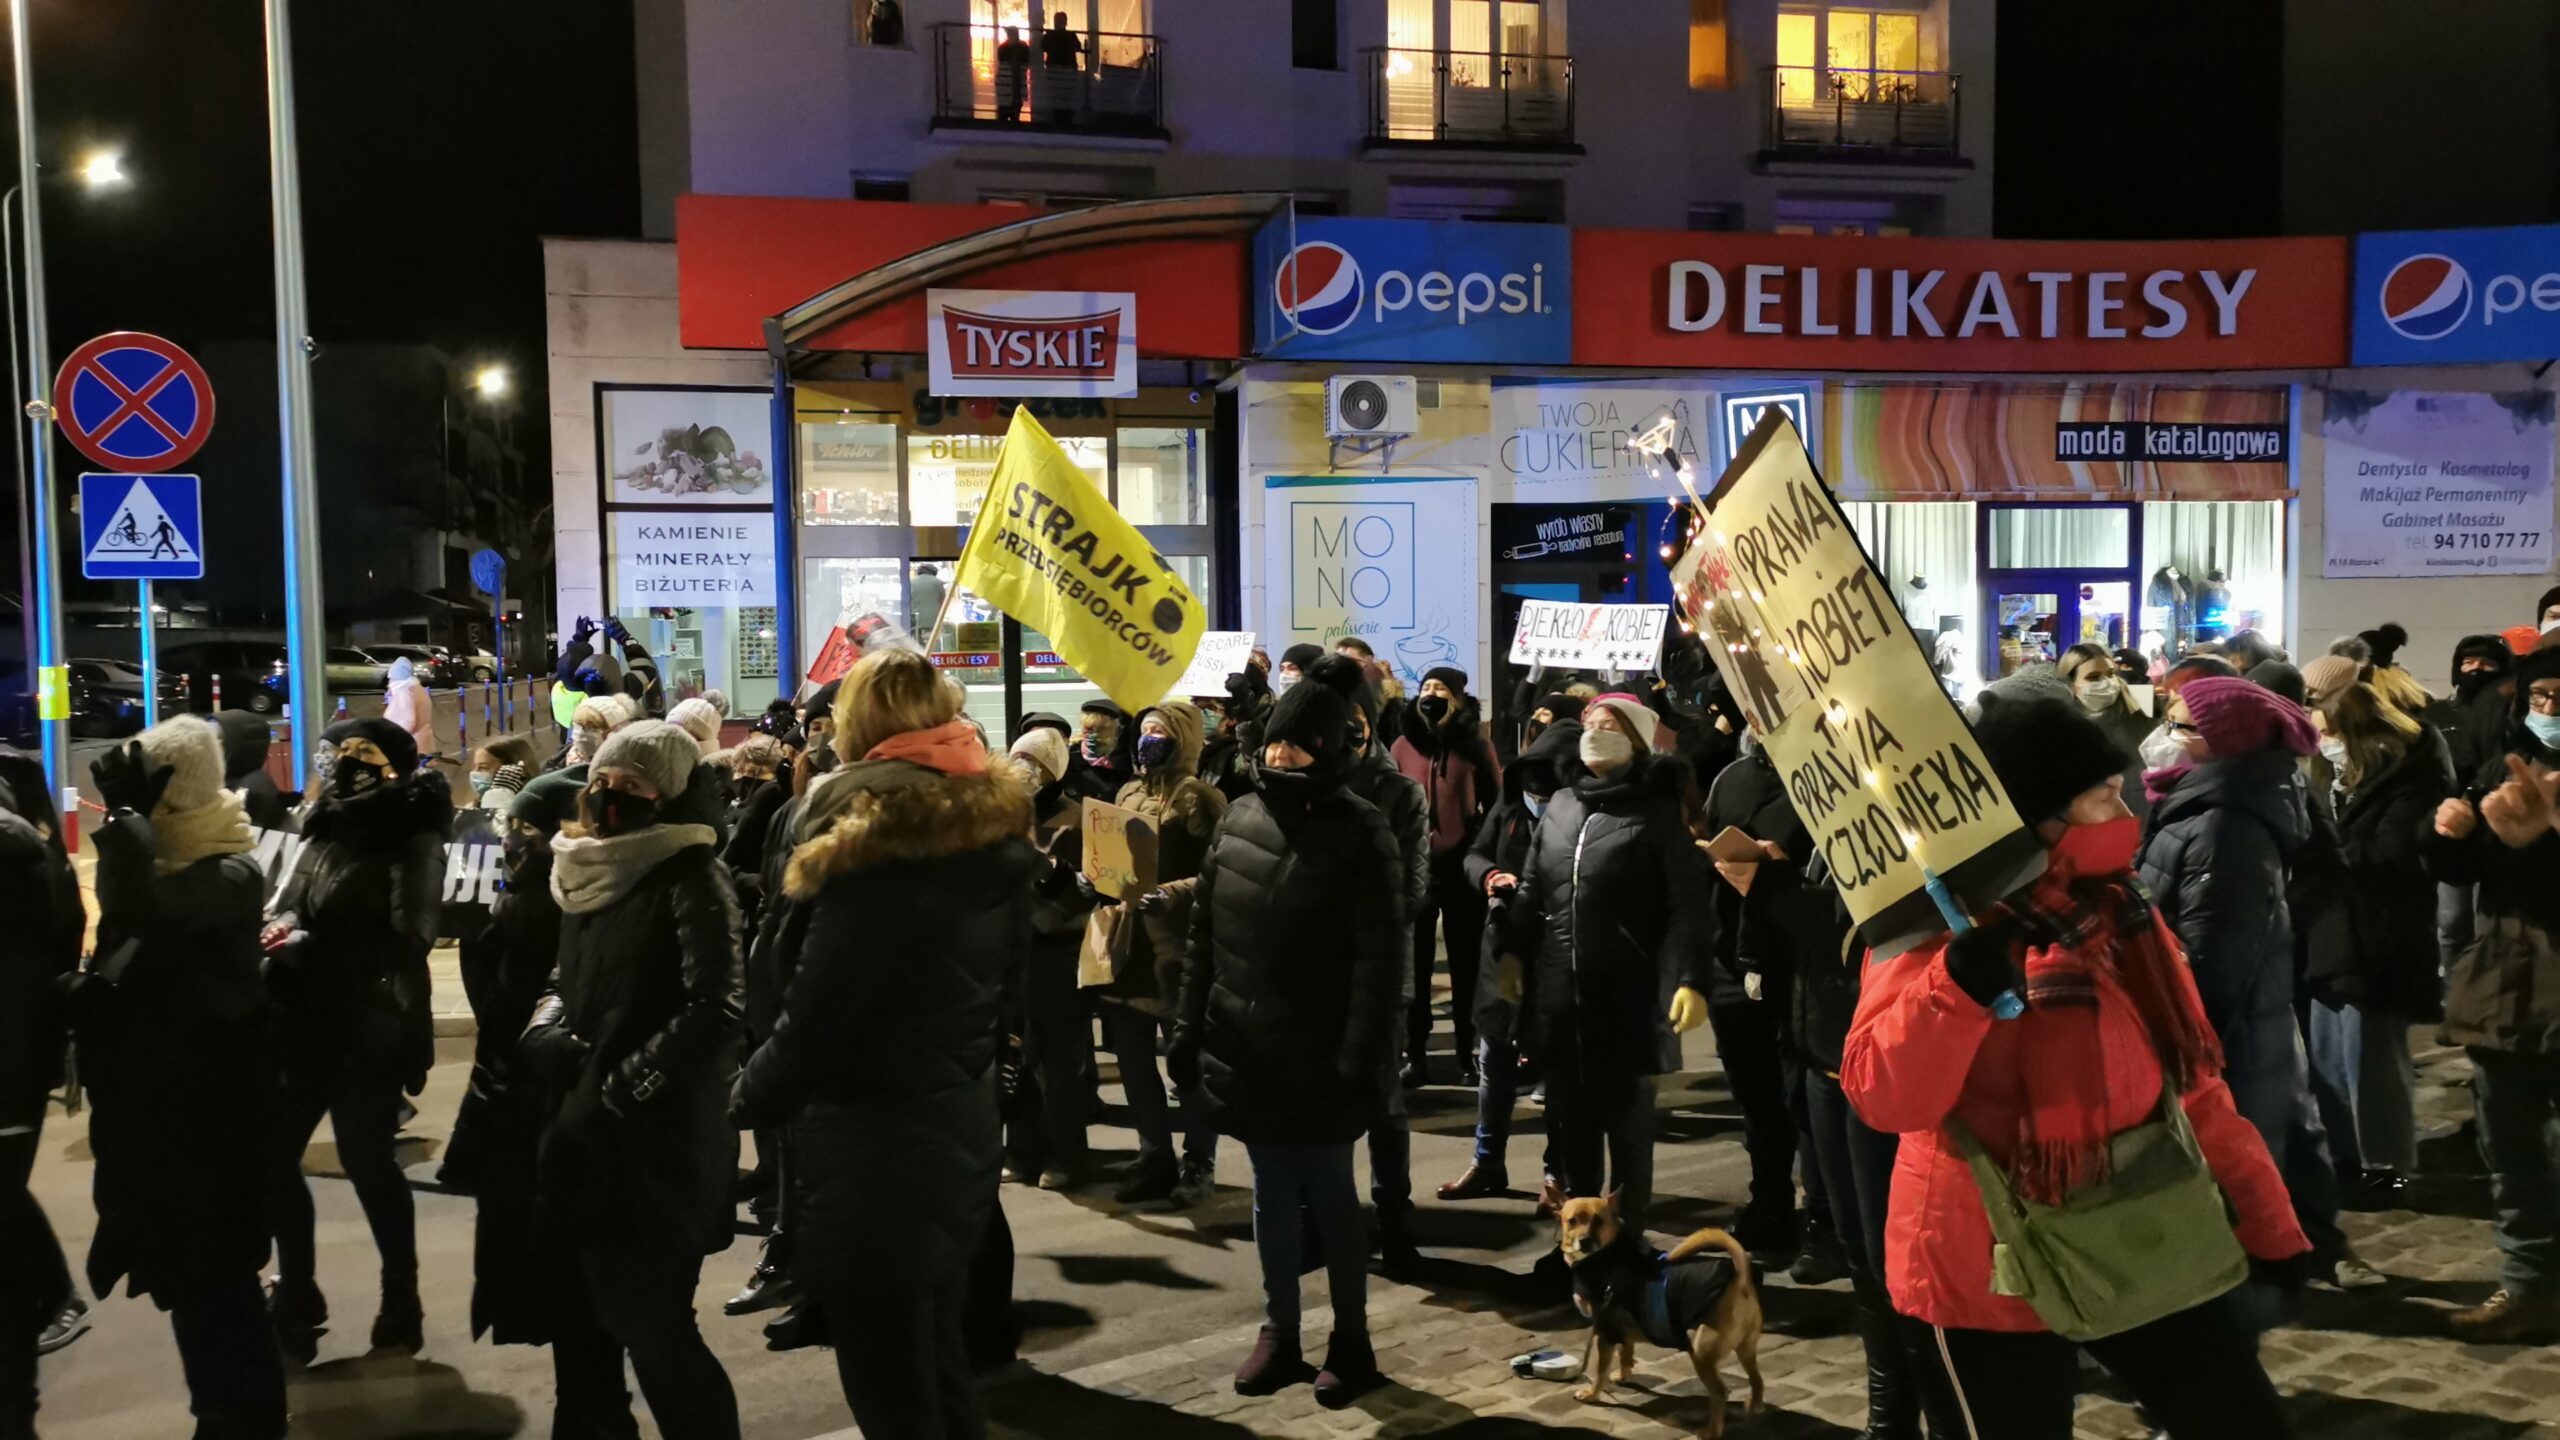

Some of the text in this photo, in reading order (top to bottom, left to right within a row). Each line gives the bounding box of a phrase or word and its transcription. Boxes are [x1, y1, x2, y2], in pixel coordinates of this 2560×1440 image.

[1375, 262, 1543, 325] pepsi
[1668, 260, 2257, 338] DELIKATESY
[957, 322, 1106, 368] TYSKIE
[1537, 401, 1621, 429] TWOJA
[2059, 425, 2125, 455] moda
[2358, 461, 2531, 480] Dentysta Kosmetolog
[2360, 487, 2528, 505] Makijaż Permanentny
[638, 526, 748, 540] KAMIENIE
[1536, 517, 1569, 540] wyrób
[2382, 512, 2506, 527] Gabinet Masażu
[1008, 481, 1153, 605] STRAJK
[1313, 515, 1395, 558] MO
[1734, 478, 1837, 597] PRAWA
[2434, 534, 2454, 549] 94
[2460, 533, 2490, 549] 710
[2495, 533, 2515, 548] 77
[2520, 533, 2540, 548] 77
[636, 553, 752, 566] MINERAŁY
[635, 575, 754, 592] BIŻUTERIA
[994, 528, 1175, 668] PRZEDSIĘBIORCÓW
[1317, 566, 1391, 608] NO
[1324, 616, 1382, 646] patisserie
[1519, 605, 1669, 642] PIEKŁO KOBIET
[1216, 633, 1251, 650] CARE
